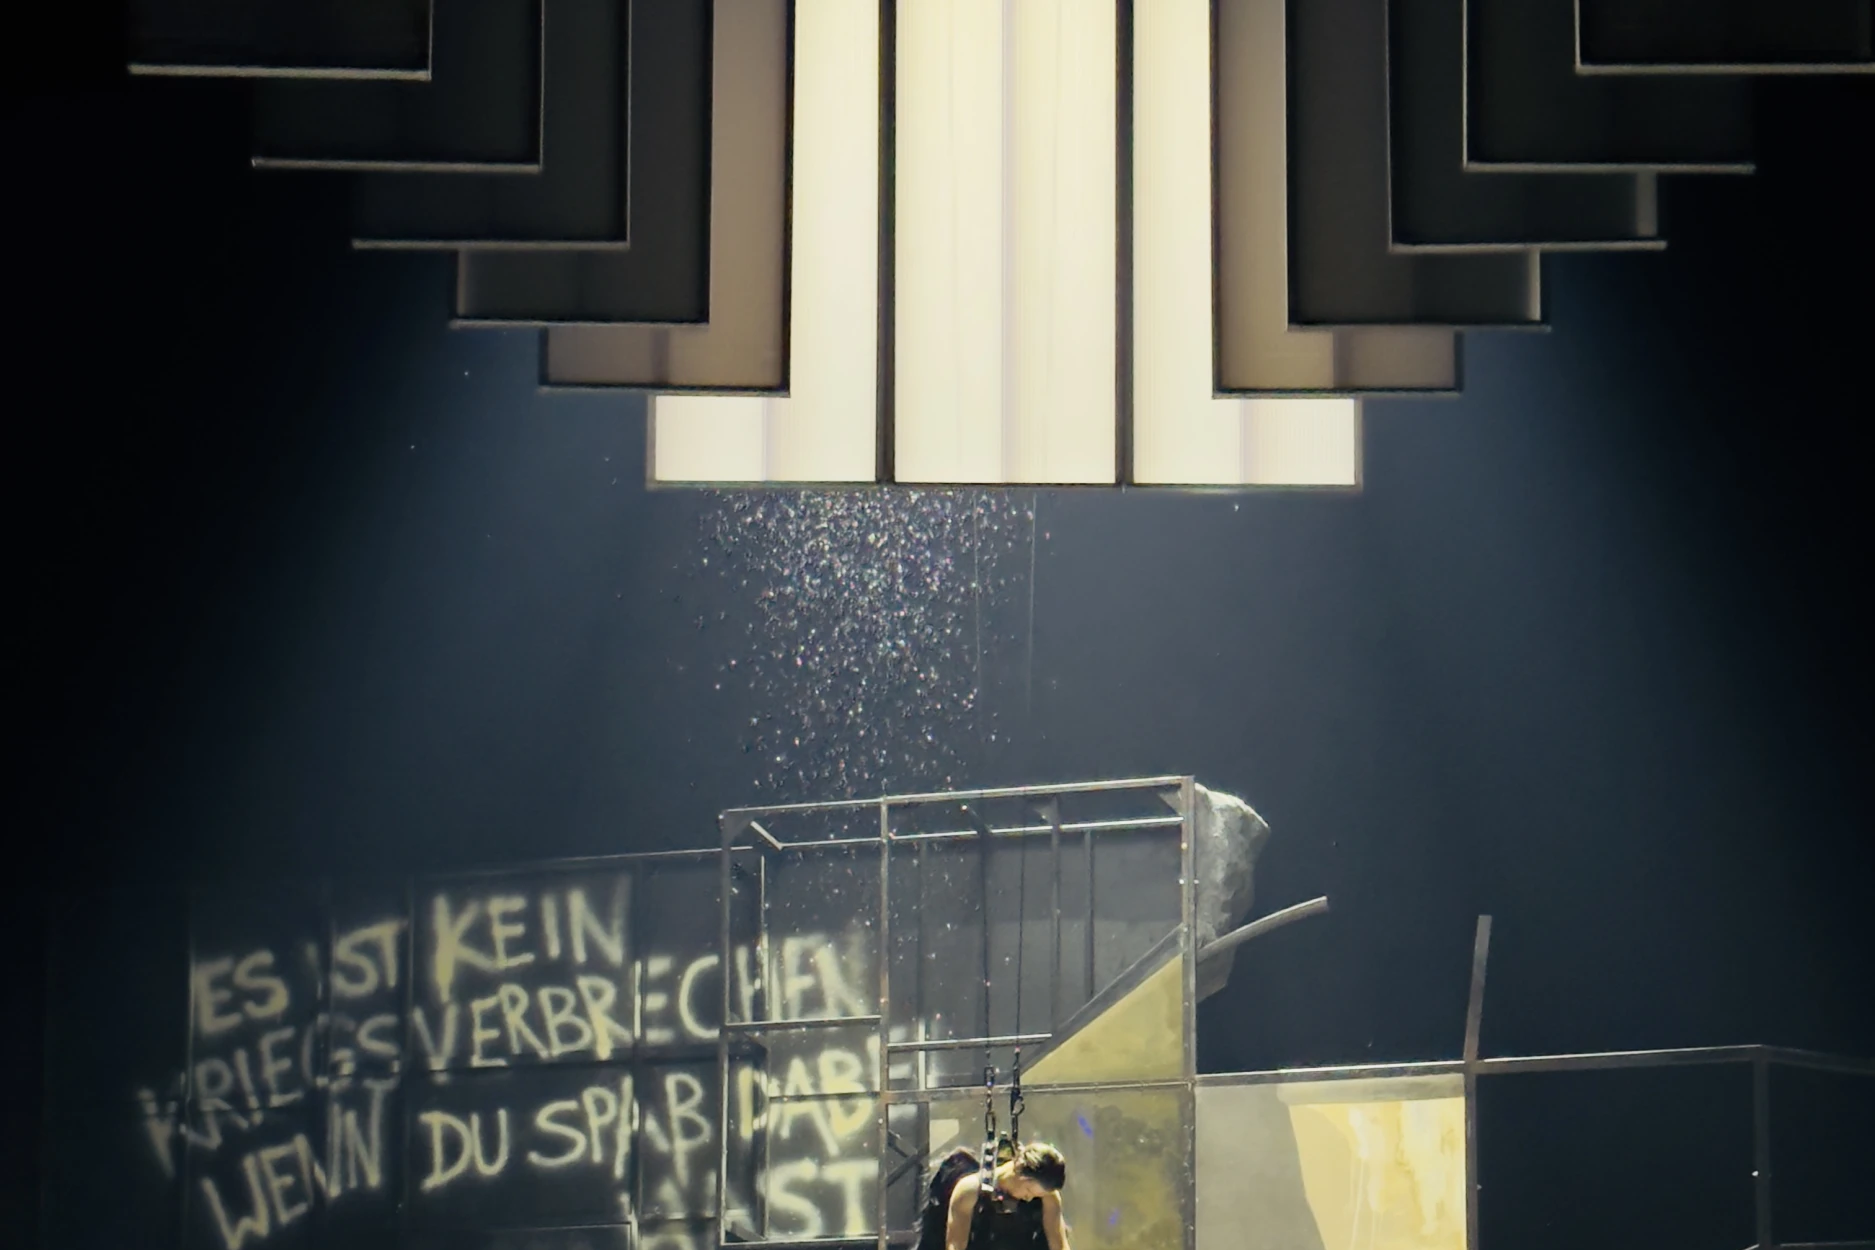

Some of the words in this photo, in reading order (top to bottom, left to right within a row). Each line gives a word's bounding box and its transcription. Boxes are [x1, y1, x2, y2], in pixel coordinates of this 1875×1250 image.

[190, 946, 291, 1036] ES
[302, 916, 407, 1001] IST
[430, 878, 632, 1004] KEIN
[417, 1107, 510, 1192] DU
